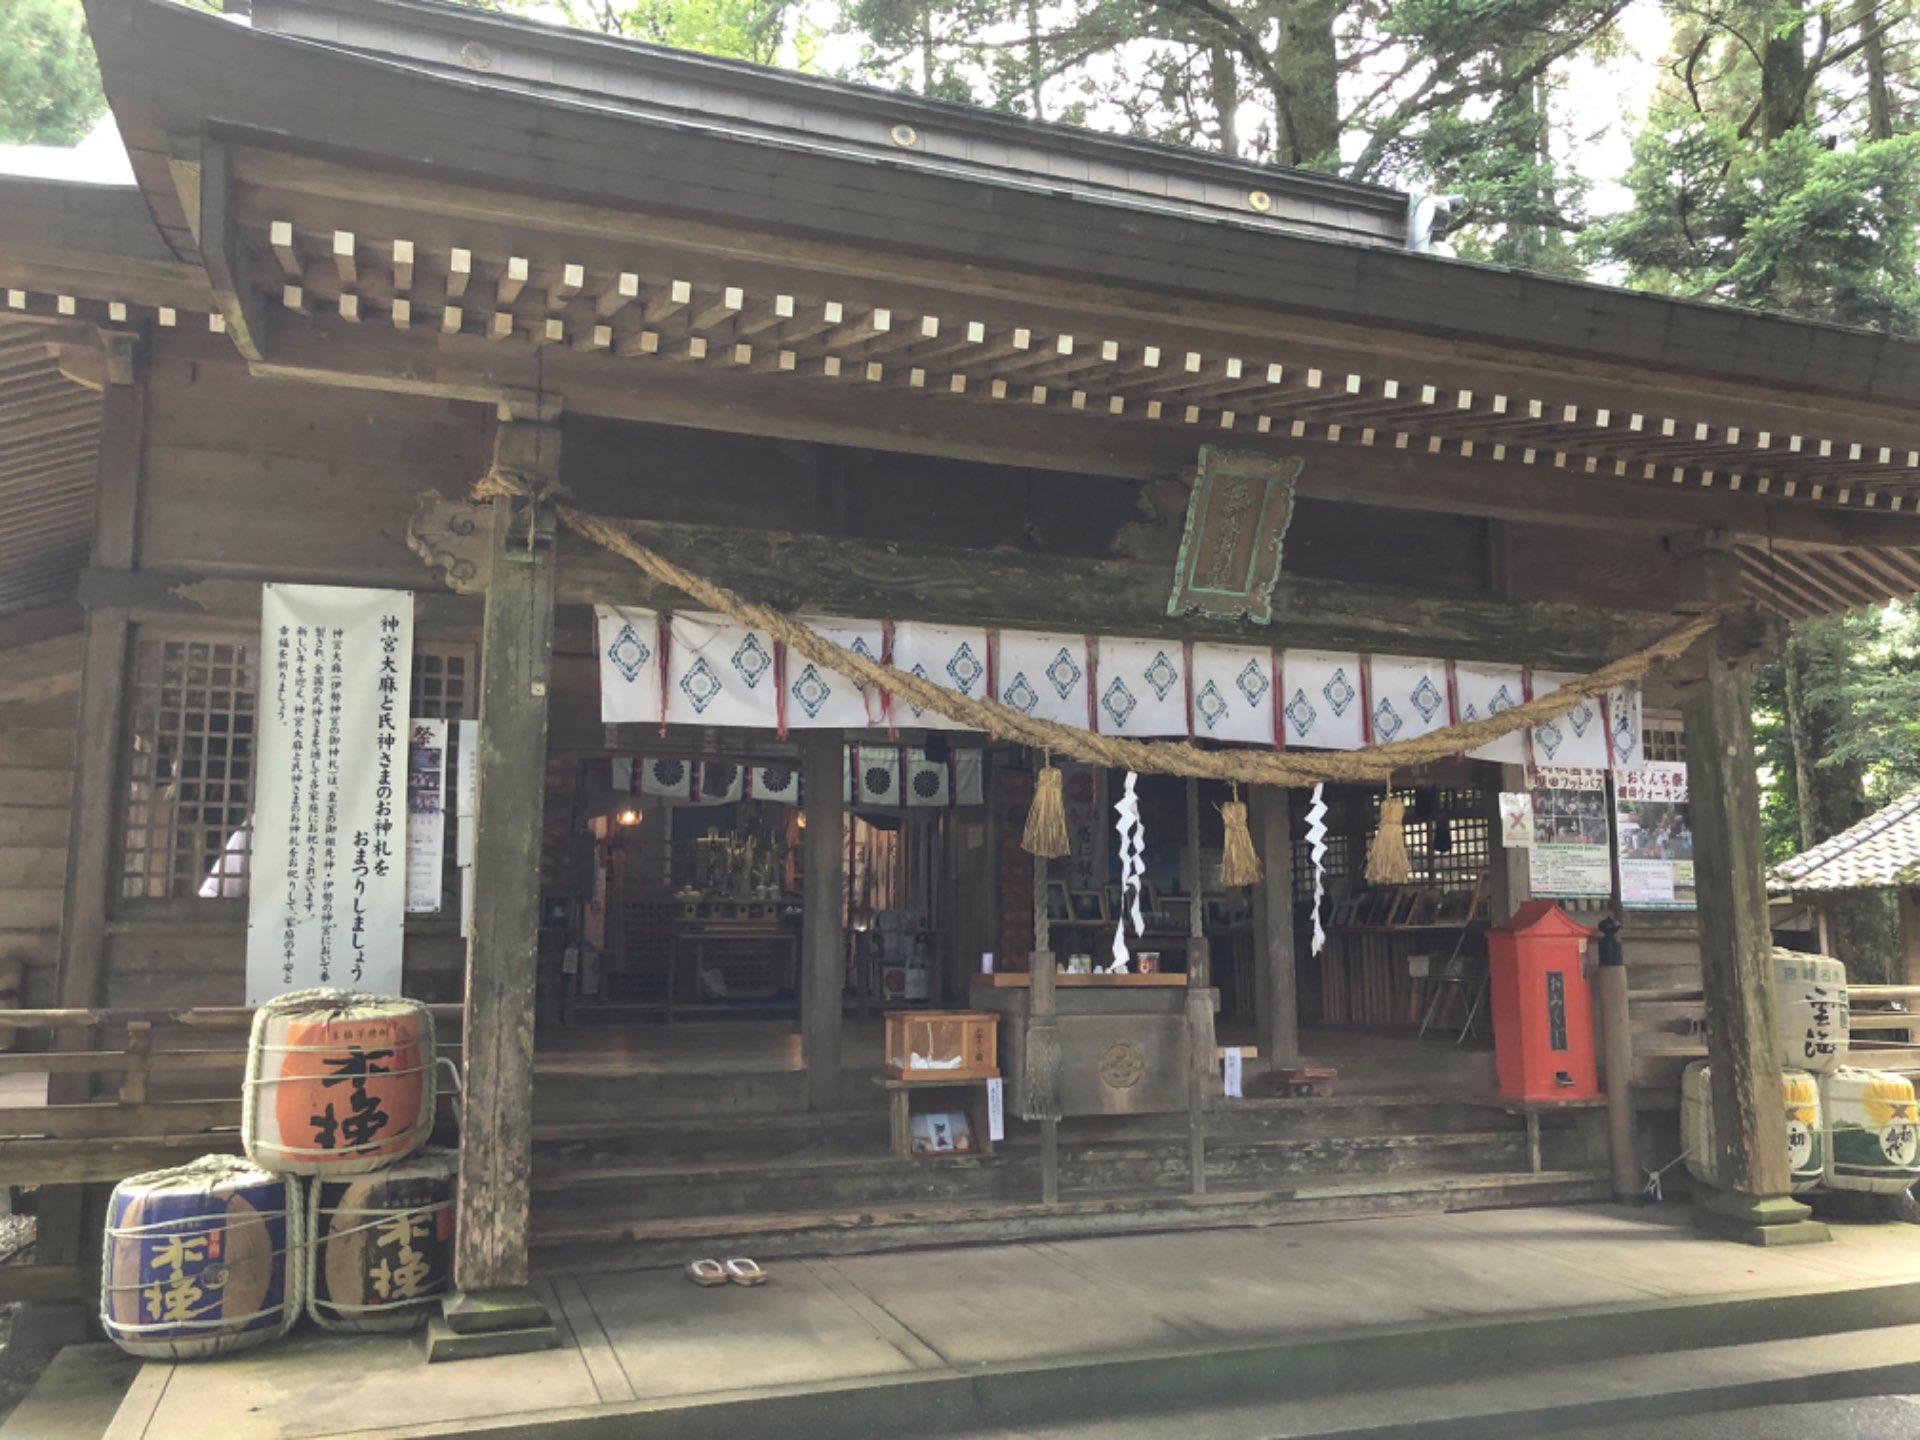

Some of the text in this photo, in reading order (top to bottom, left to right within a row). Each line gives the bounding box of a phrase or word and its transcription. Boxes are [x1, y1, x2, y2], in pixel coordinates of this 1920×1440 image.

[277, 625, 290, 726] 幸福を祈りましょう。
[373, 615, 400, 877] 神宮大麻と氏神さまのお神札を
[413, 725, 435, 747] 祭
[1628, 771, 1684, 787] おくんち祭
[350, 830, 369, 983] おまつりしましょう
[1549, 974, 1565, 1049] おみくじ
[144, 1236, 210, 1321] 木挽
[370, 1215, 433, 1299] 木挽
